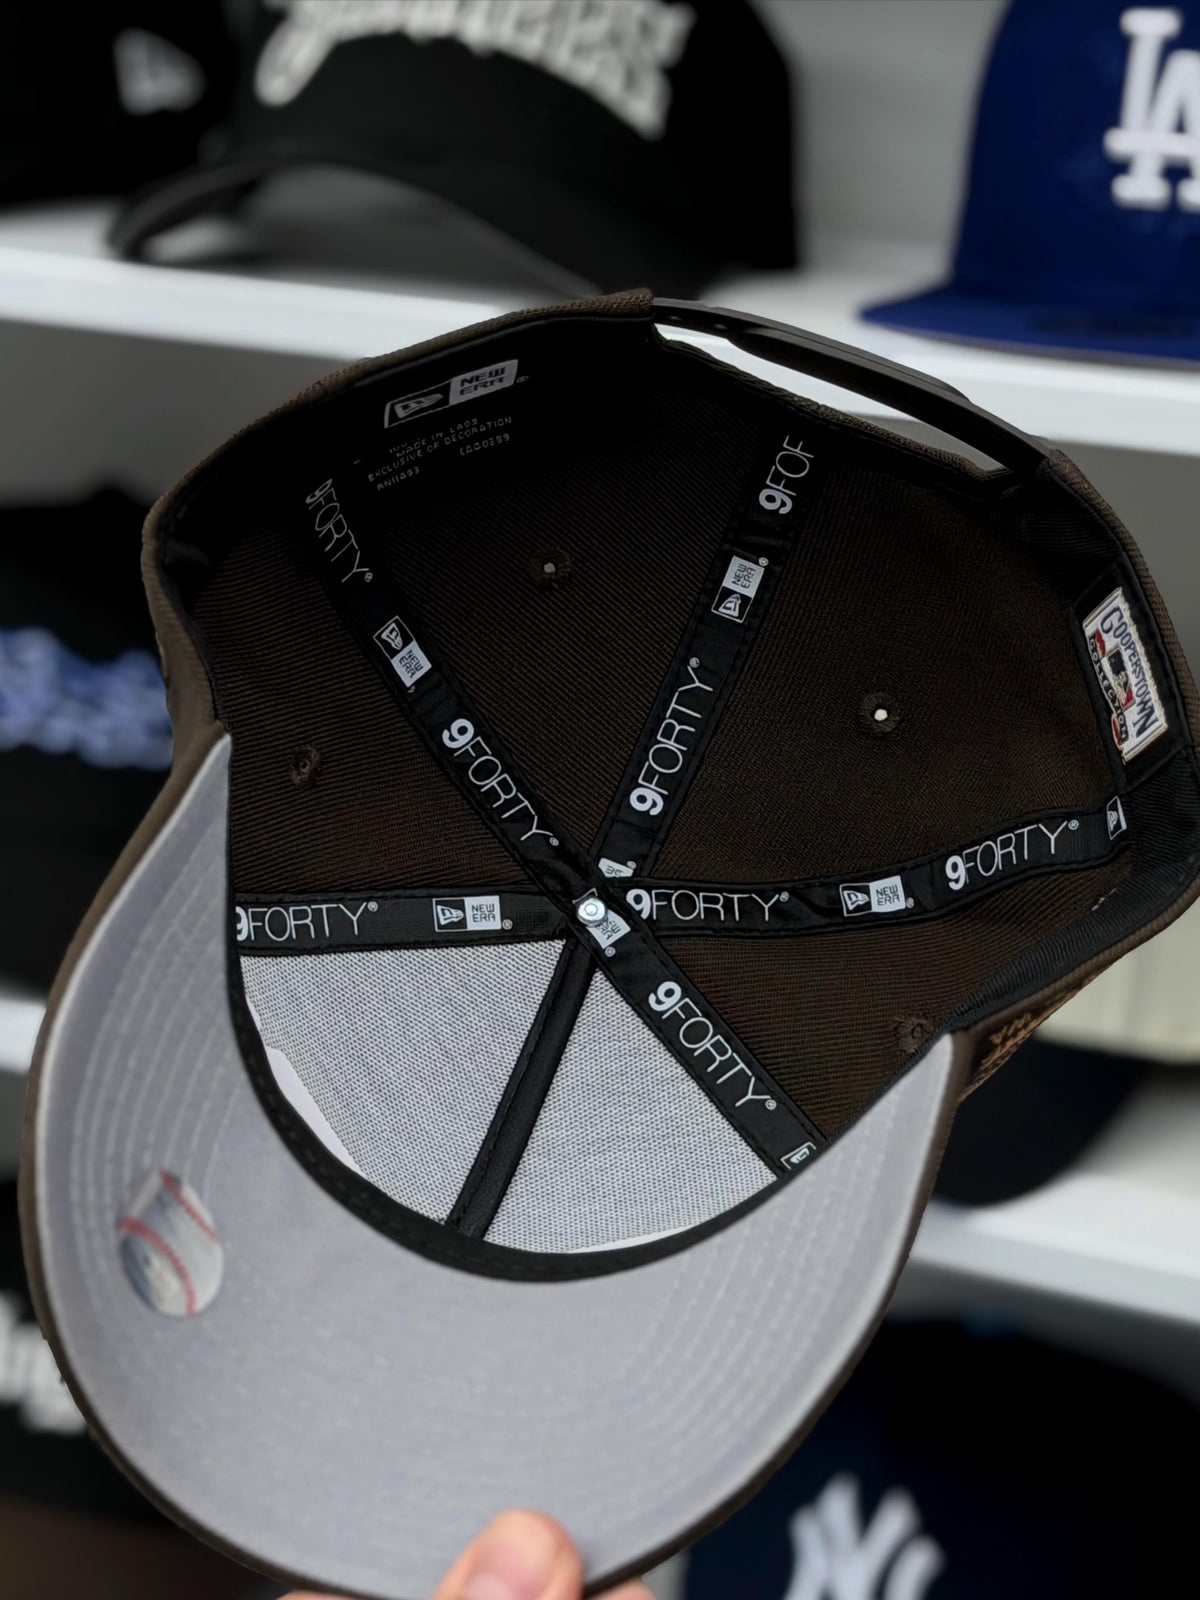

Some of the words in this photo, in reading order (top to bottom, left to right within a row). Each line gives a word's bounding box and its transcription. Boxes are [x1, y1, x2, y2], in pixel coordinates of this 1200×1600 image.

[1102, 6, 1200, 212] LA
[459, 376, 505, 396] ERA
[460, 366, 506, 387] NEW
[431, 431, 443, 441] IN
[449, 418, 479, 433] LAOS
[368, 449, 423, 482] EXCLUSIVE
[427, 441, 440, 453] OF
[444, 416, 512, 445] DECORATION
[305, 478, 370, 583] 9FORTY
[731, 563, 747, 586] NEW
[740, 567, 757, 590] ERA
[398, 656, 416, 679] ERA
[406, 649, 424, 672] NEW
[1100, 606, 1160, 738] COOPERSTOWN
[1088, 633, 1129, 744] COLLECTION
[629, 664, 714, 816] 9FORTY
[441, 718, 554, 842] 9FORTY
[945, 820, 1068, 891] 9FORTY
[875, 884, 898, 898] NEW
[877, 894, 901, 906] ERA
[471, 903, 496, 914] NEW
[625, 888, 780, 922] 9FORTY
[471, 914, 497, 924] ERA
[647, 981, 772, 1108] 9FORTY
